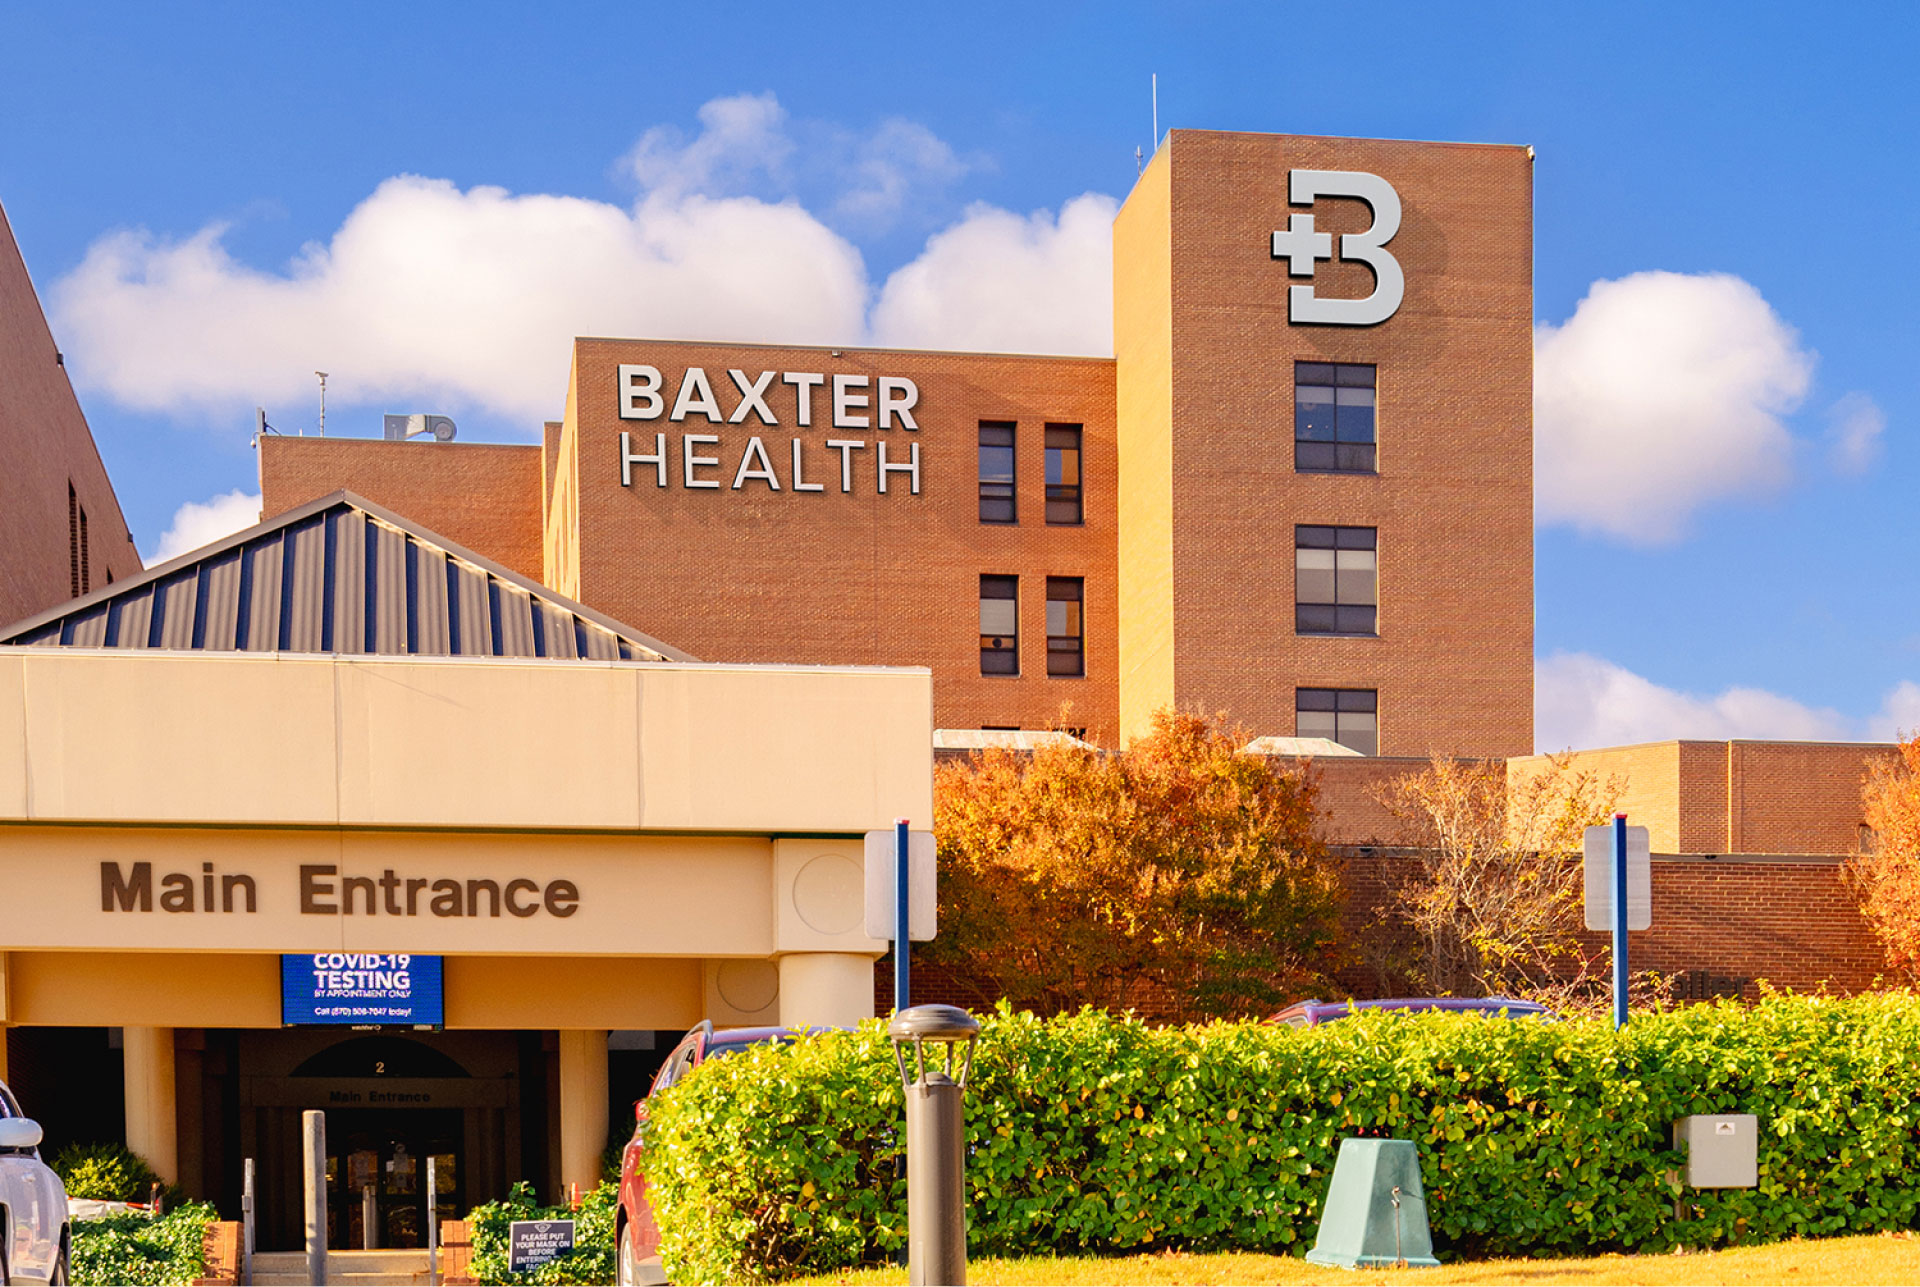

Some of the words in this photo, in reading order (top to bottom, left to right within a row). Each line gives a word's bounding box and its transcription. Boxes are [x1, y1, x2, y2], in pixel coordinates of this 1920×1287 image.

[618, 364, 919, 431] BAXTER
[620, 431, 920, 494] HEALTH
[100, 861, 257, 913] Main
[299, 864, 580, 918] Entrance
[313, 953, 411, 969] COVID-19
[313, 970, 411, 989] TESTING
[314, 989, 326, 998] BY
[326, 989, 387, 998] APPOINTMENT
[388, 989, 411, 998] ONLY
[314, 1007, 330, 1016] Call
[375, 1061, 385, 1073] 2
[330, 1091, 361, 1102] Main
[369, 1091, 431, 1103] Entrance
[521, 1233, 548, 1241] PLEASE
[549, 1232, 565, 1240] PUT
[515, 1241, 535, 1249] YOUR
[528, 1248, 556, 1256] BEFORE
